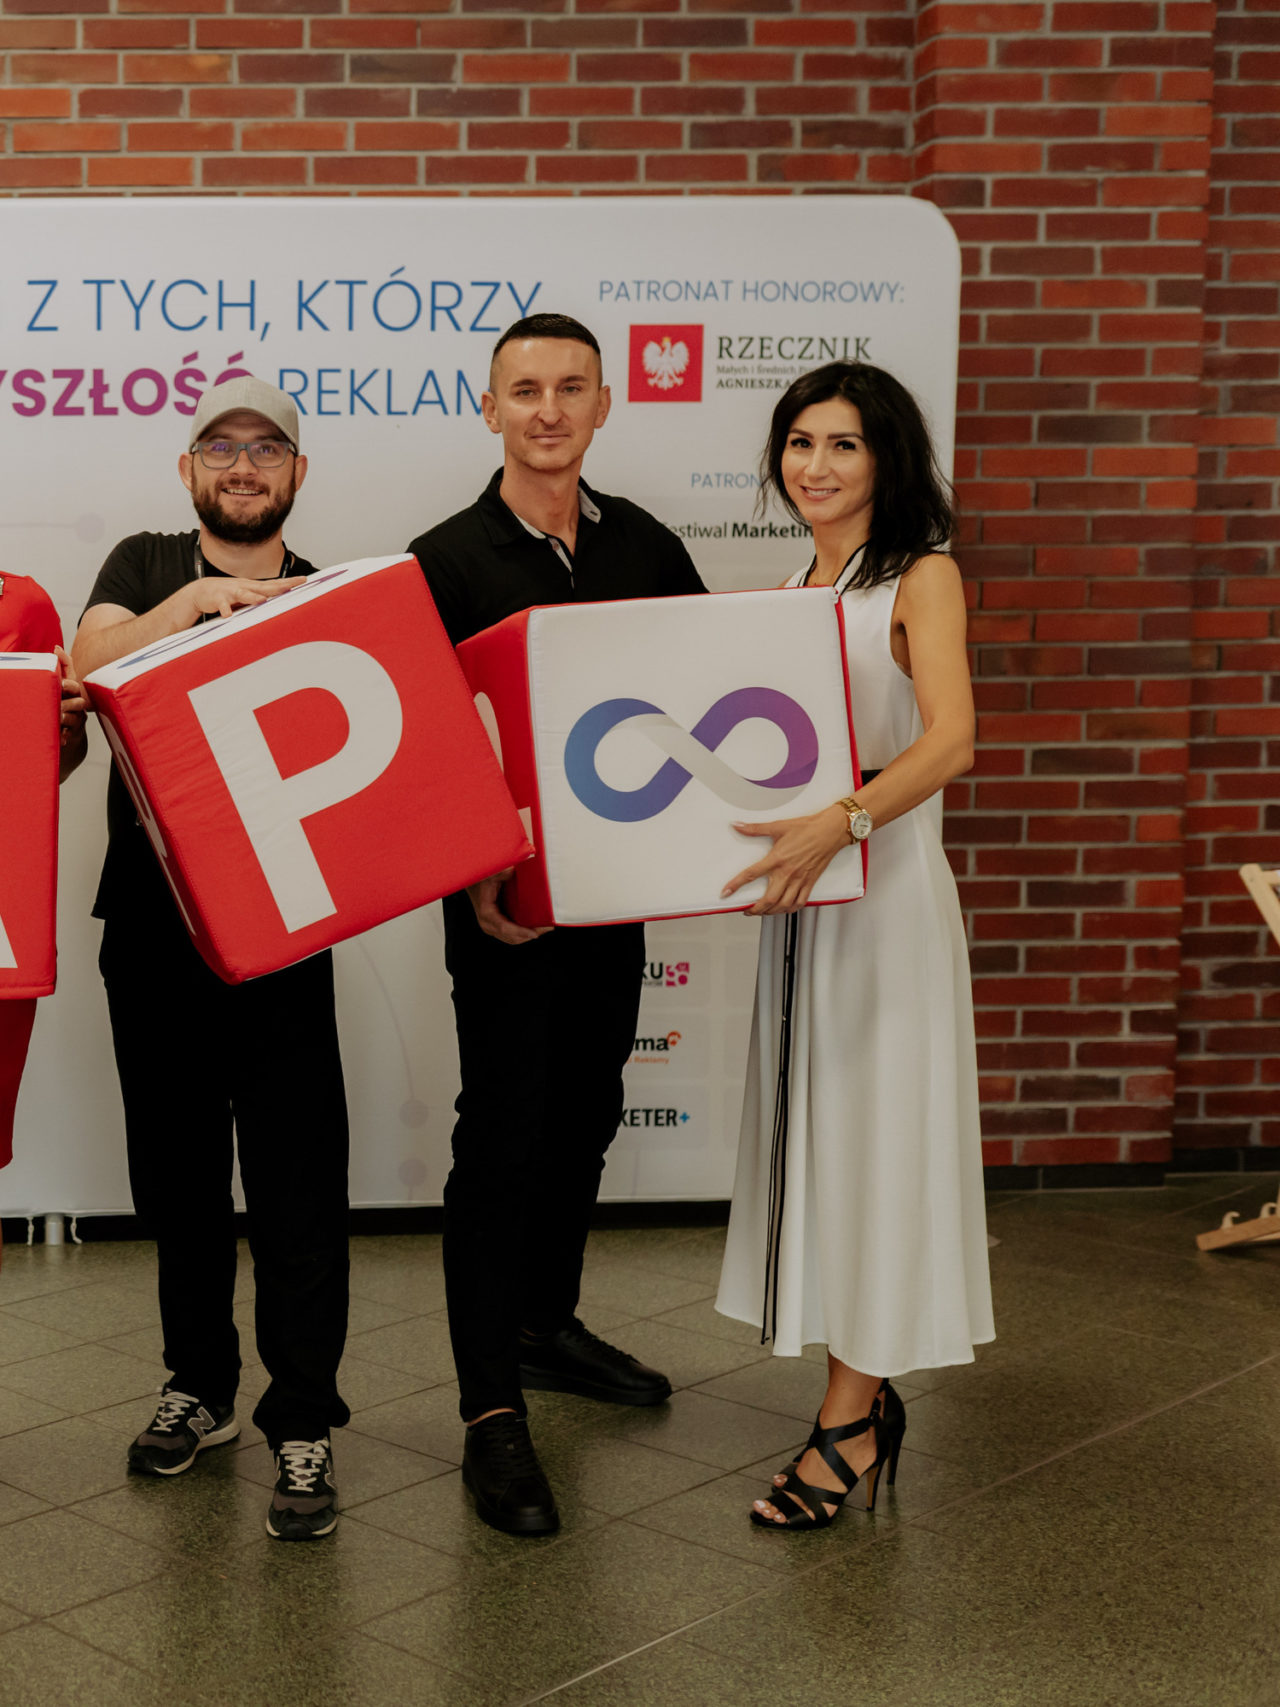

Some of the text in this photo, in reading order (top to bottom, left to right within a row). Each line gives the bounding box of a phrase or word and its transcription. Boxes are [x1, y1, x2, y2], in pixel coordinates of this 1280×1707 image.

[26, 279, 60, 333] Z
[82, 279, 271, 342] TYCH,
[297, 266, 542, 333] KTÓRZY
[598, 280, 905, 303] PATRONAT HONOROWY:
[717, 335, 873, 361] RZECZNIK
[186, 640, 404, 935] P
